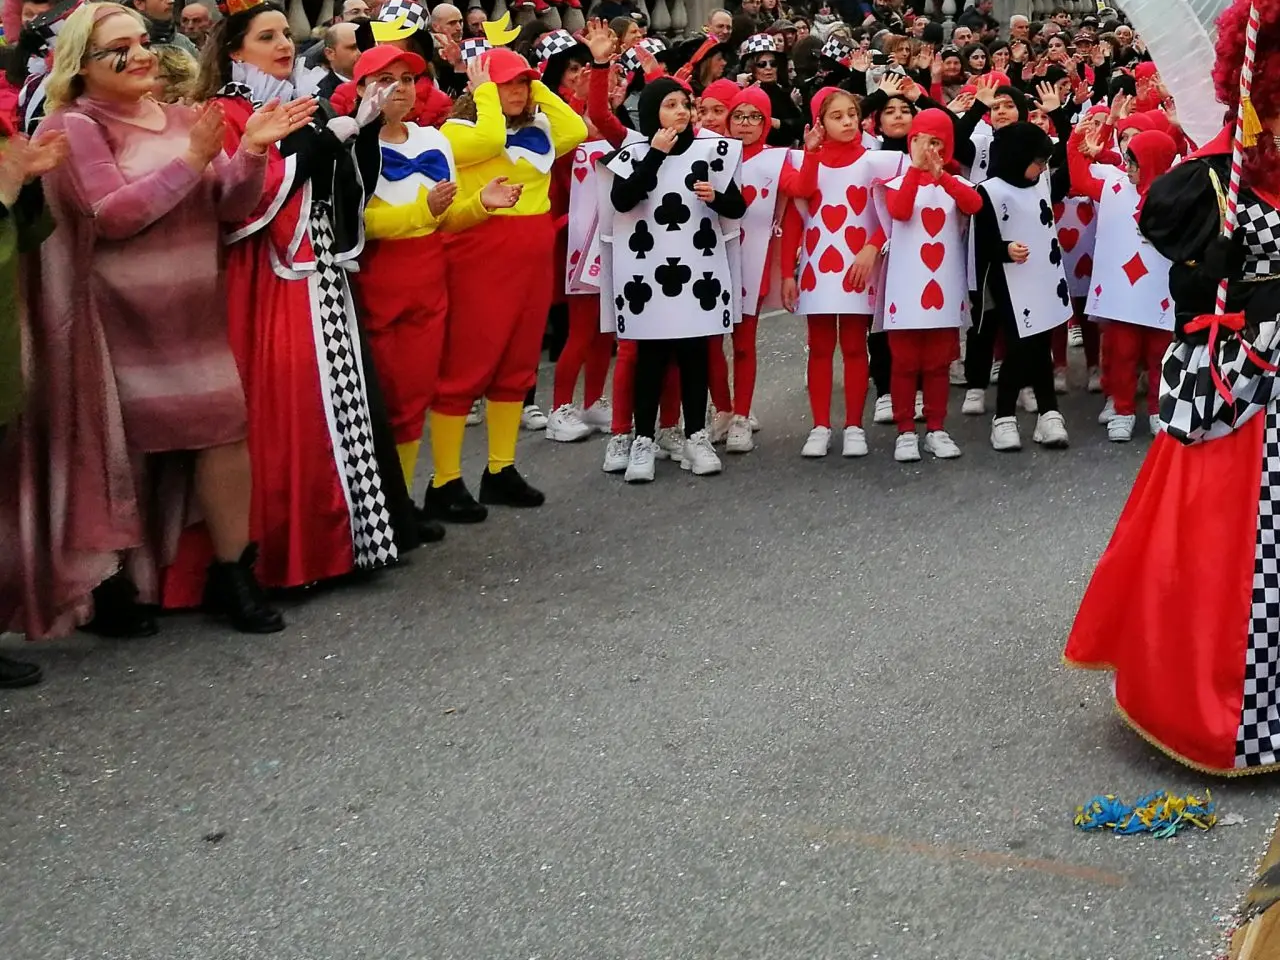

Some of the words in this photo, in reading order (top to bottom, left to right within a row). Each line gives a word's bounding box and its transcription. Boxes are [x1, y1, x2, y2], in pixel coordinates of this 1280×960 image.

[717, 140, 728, 156] 8
[618, 315, 625, 333] 8
[723, 310, 730, 328] 8
